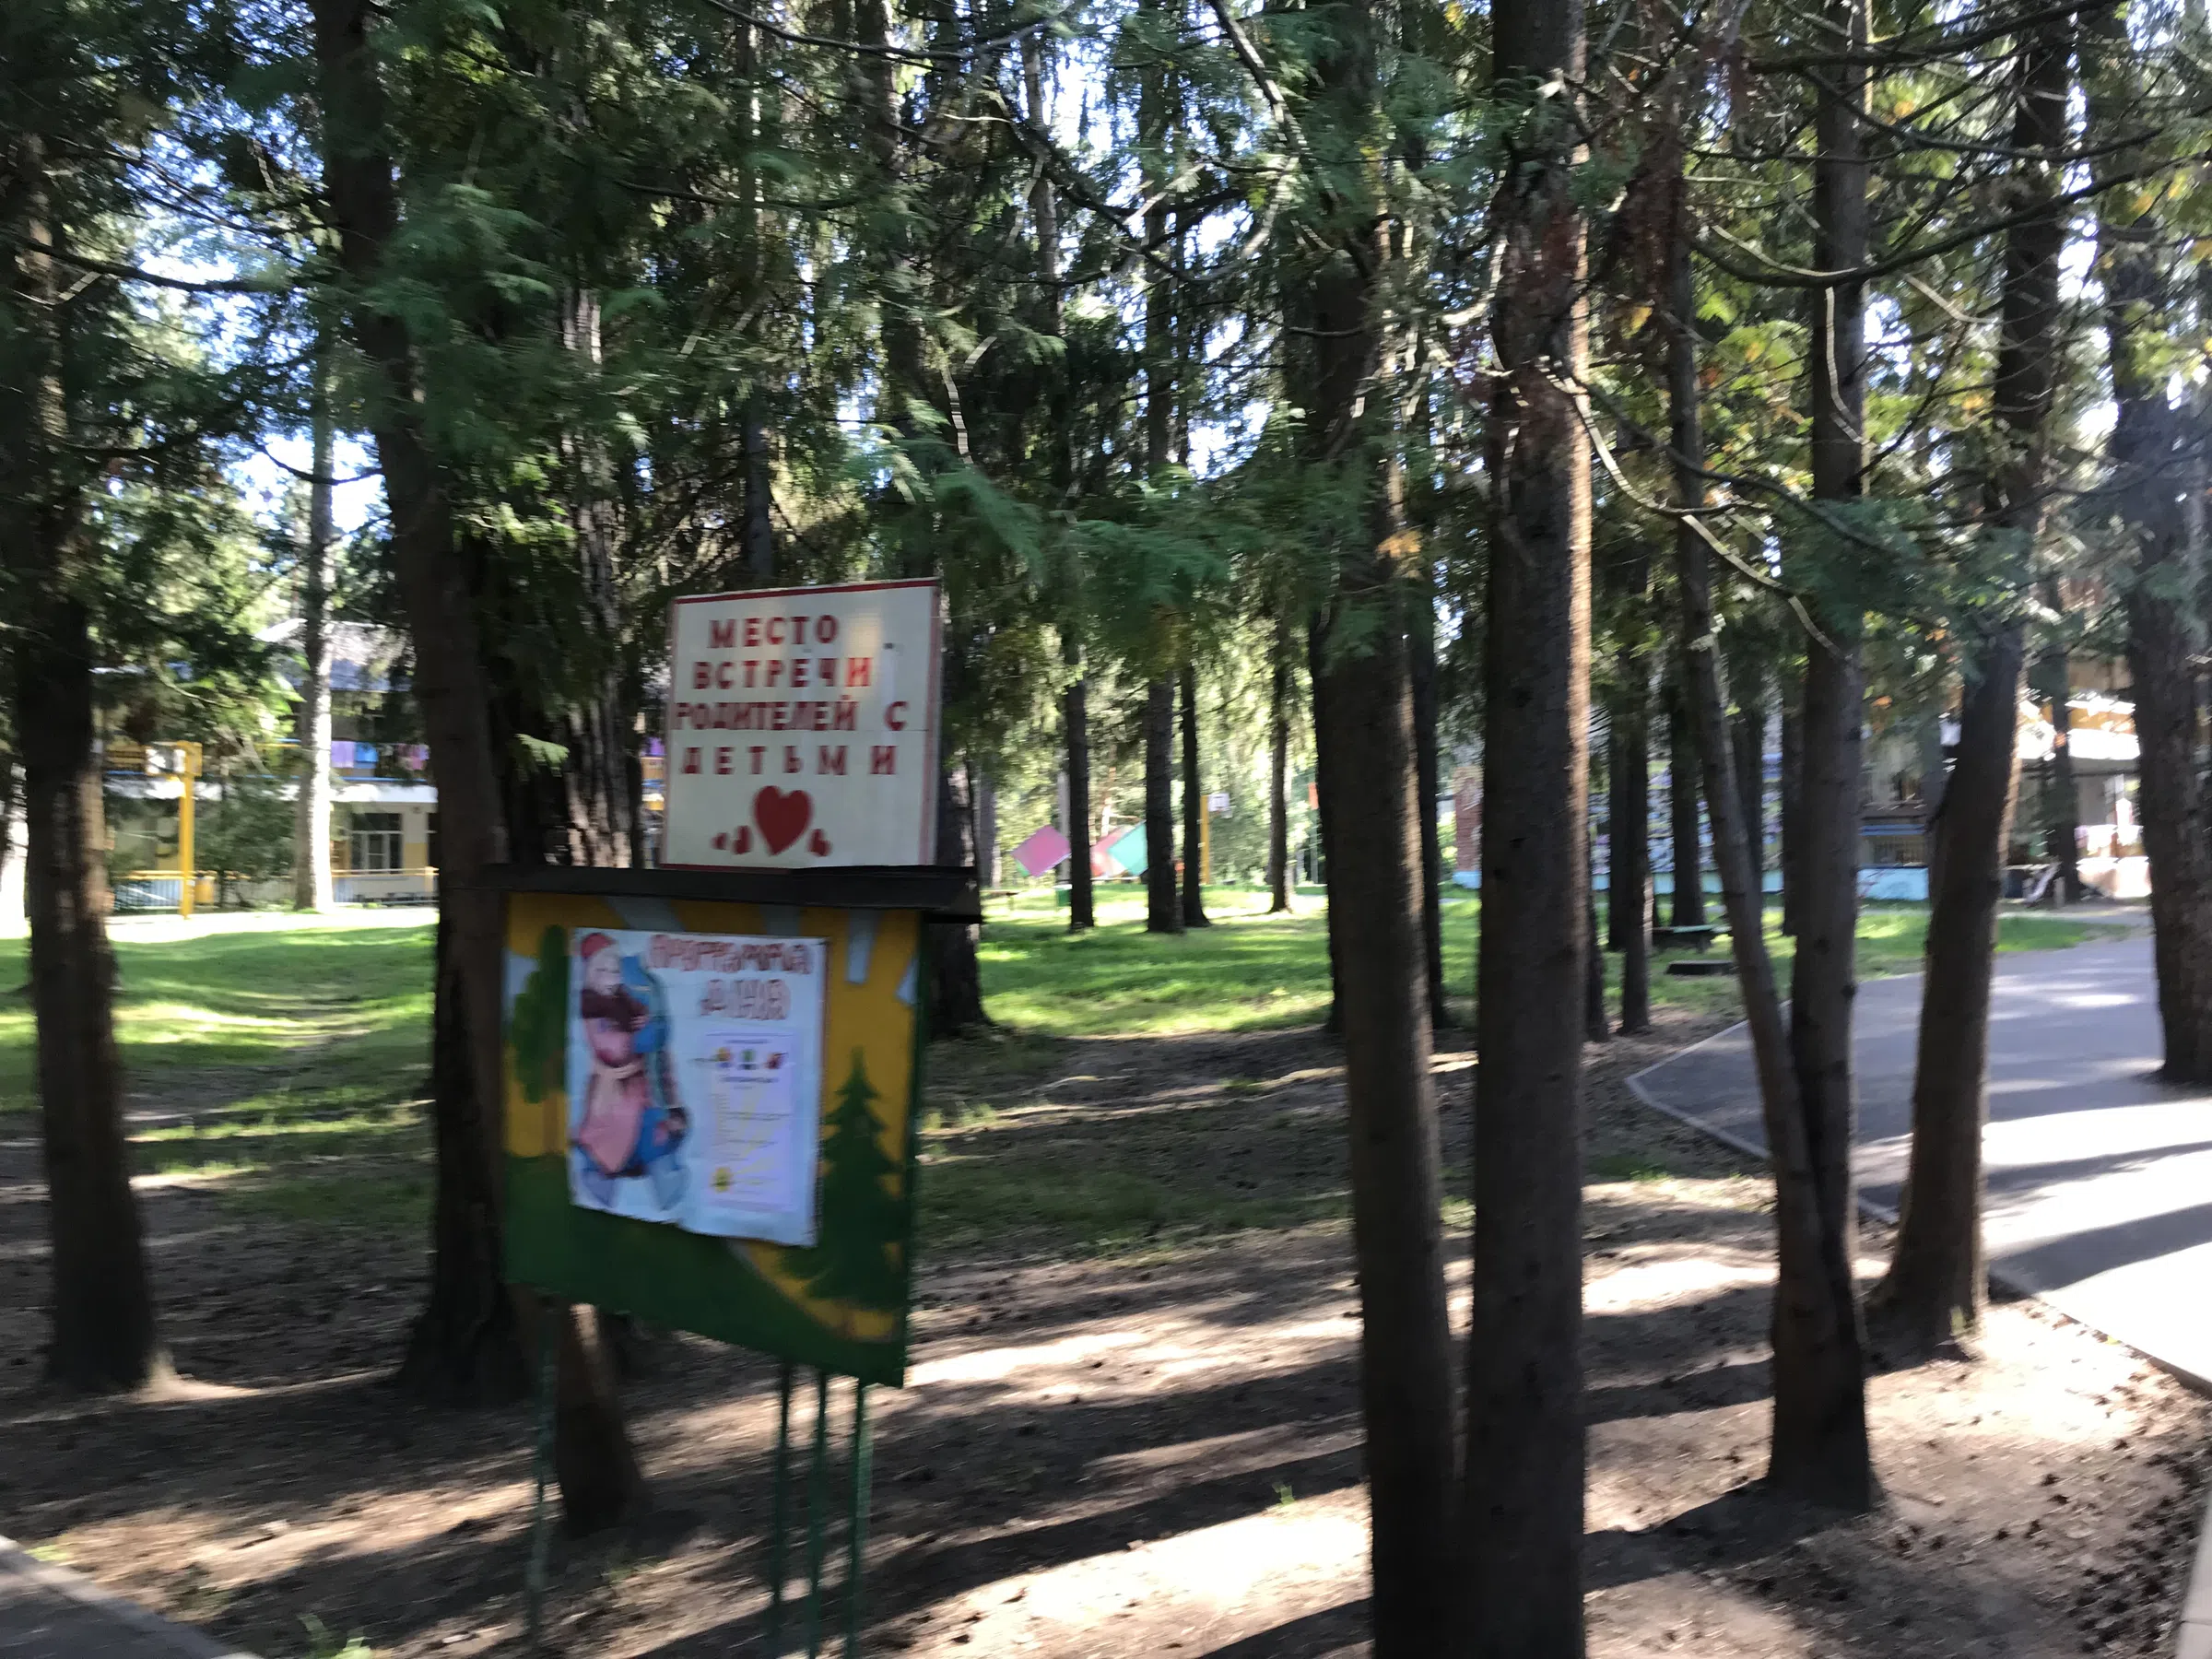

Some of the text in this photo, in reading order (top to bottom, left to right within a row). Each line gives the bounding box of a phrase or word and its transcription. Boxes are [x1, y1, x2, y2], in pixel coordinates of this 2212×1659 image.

[708, 615, 839, 648] МЕСТО
[693, 658, 872, 688] ВСТРЕЧИ
[672, 696, 910, 731] РОДИТЕЛЕЙ С
[682, 747, 897, 774] ДЕТЬМИ
